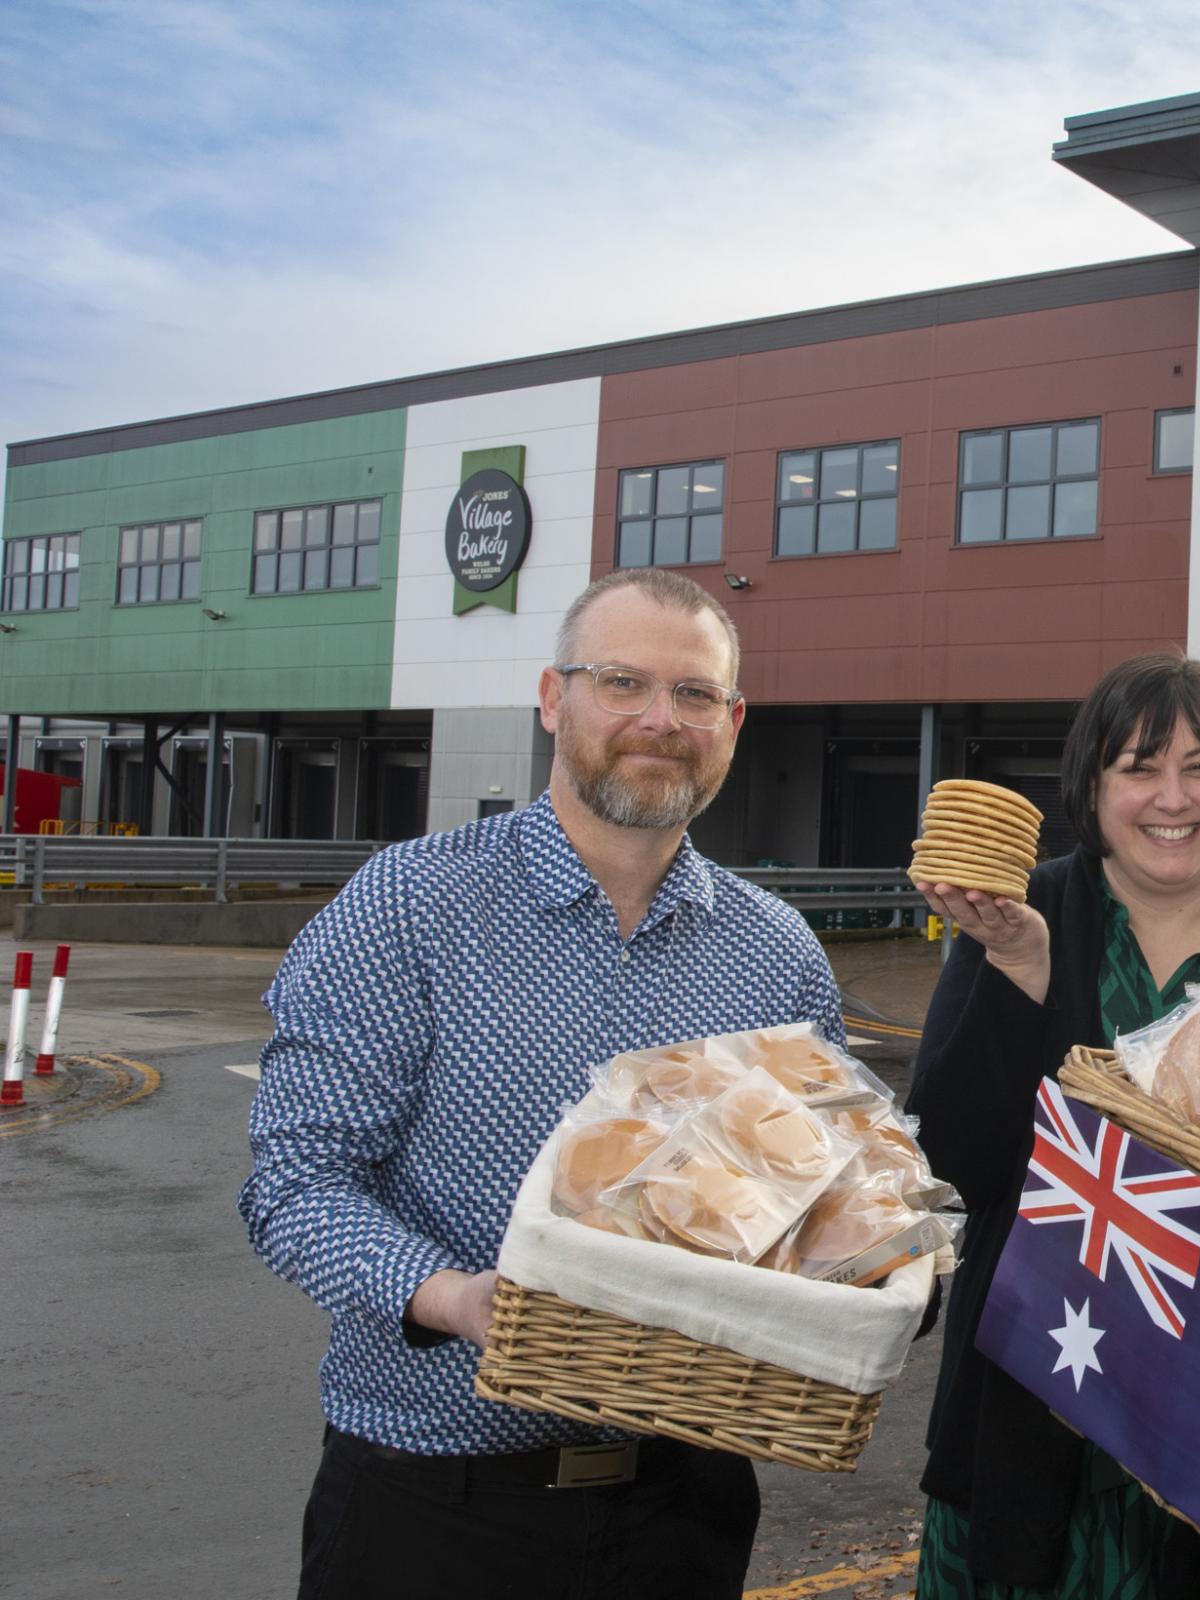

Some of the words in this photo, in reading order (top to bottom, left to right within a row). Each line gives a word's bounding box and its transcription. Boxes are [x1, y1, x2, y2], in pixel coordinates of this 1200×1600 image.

[482, 491, 508, 501] JONES
[459, 496, 512, 540] Village
[458, 532, 508, 565] Bakery
